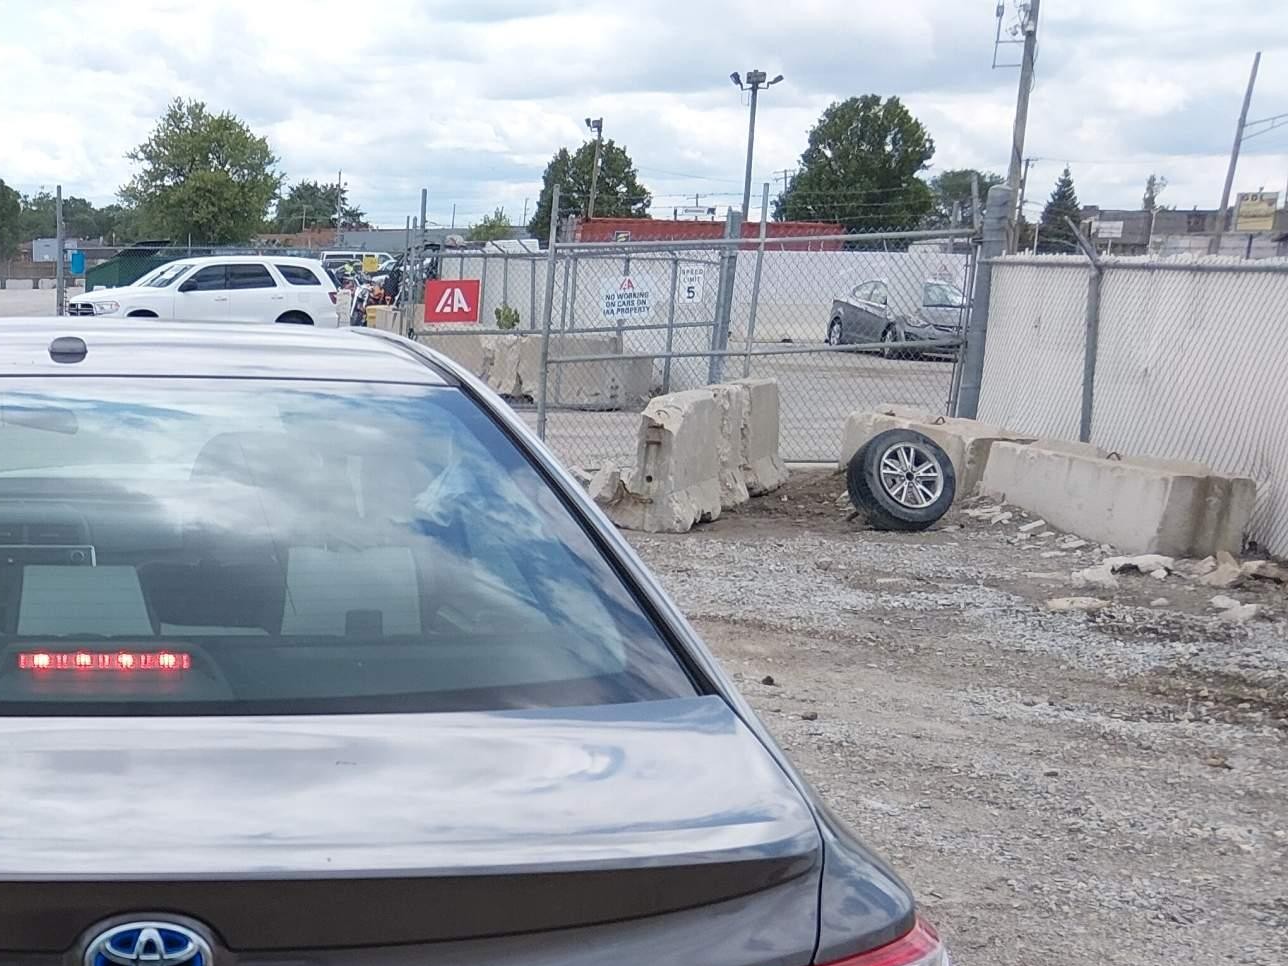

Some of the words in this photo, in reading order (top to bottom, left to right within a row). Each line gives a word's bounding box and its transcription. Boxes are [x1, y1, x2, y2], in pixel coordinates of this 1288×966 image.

[617, 292, 650, 300] WORKING
[686, 286, 696, 299] 5
[616, 306, 650, 315] PROPERTY
